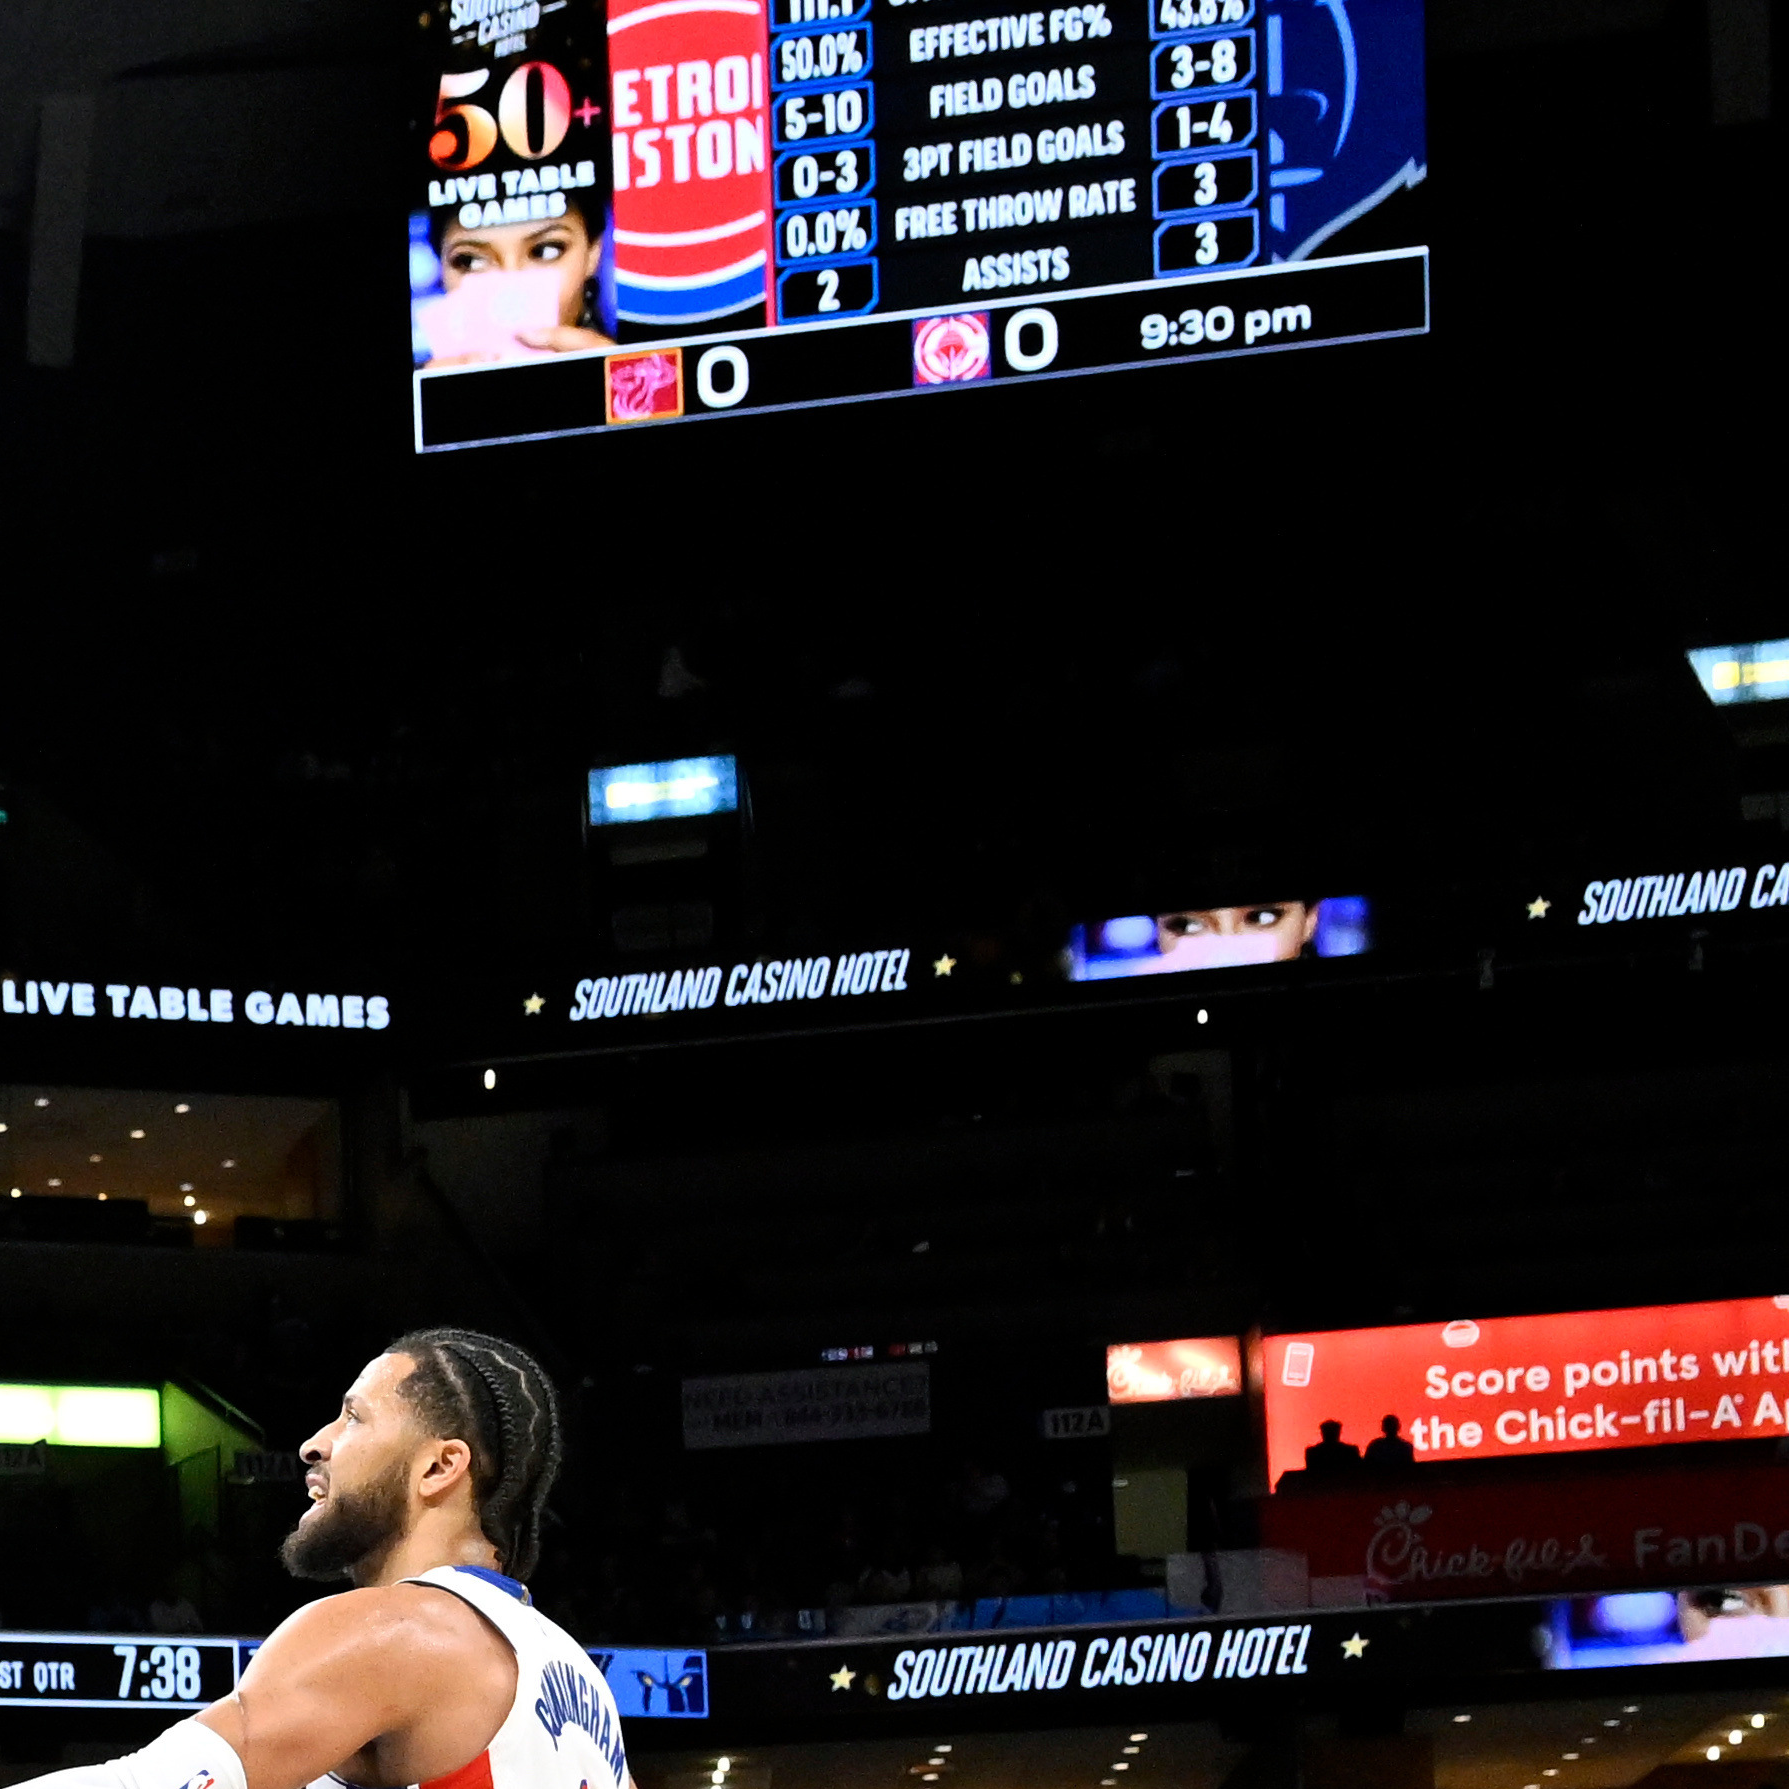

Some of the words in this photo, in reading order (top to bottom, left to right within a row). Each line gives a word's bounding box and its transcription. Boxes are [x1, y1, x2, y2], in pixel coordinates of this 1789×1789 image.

[781, 32, 864, 83] 50.0%
[909, 11, 1045, 63] EFFECTIVE
[1049, 3, 1113, 44] FG%
[612, 52, 763, 128] ETROI
[784, 89, 863, 141] 5-10
[929, 76, 1002, 120] FIELD
[1007, 64, 1097, 109] GOALS
[1170, 38, 1238, 90] 3-8
[428, 173, 497, 208] LIVE
[501, 159, 596, 197] TABLE
[612, 114, 765, 192] ISTON
[793, 150, 859, 199] 0-3
[902, 142, 954, 183] 3PT
[958, 132, 1033, 175] FIELD
[1036, 120, 1125, 166] GOALS
[1176, 101, 1234, 149] 1-4
[458, 191, 568, 229] GAMES
[786, 208, 868, 259] 0.0%
[895, 199, 959, 242] FREE
[962, 187, 1064, 235] THROW
[1068, 178, 1137, 220] RATE
[1193, 162, 1218, 206] 3
[816, 269, 841, 313] 2
[962, 245, 1072, 293] ASSISTS
[1194, 221, 1220, 266] 3
[696, 345, 750, 408] 0
[1003, 308, 1059, 373] 0
[1139, 304, 1235, 350] 9:30
[1242, 299, 1313, 345] pm
[1577, 867, 1749, 926] SOUTHLAND
[1, 978, 95, 1018] LIVE
[106, 982, 234, 1024] TABLE
[244, 988, 391, 1030] GAMES
[568, 964, 722, 1021] SOUTHLAND
[724, 955, 829, 1008] CASINO
[833, 947, 911, 999] HOTEL
[1424, 1360, 1550, 1399] Score
[1563, 1350, 1699, 1396] points
[1412, 1410, 1483, 1450] the
[32, 1660, 76, 1695] QTR
[113, 1645, 202, 1701] 7:38
[887, 1636, 1078, 1701] SOUTHLAND
[1081, 1630, 1209, 1688] CASINO
[1214, 1623, 1313, 1678] HOTEL
